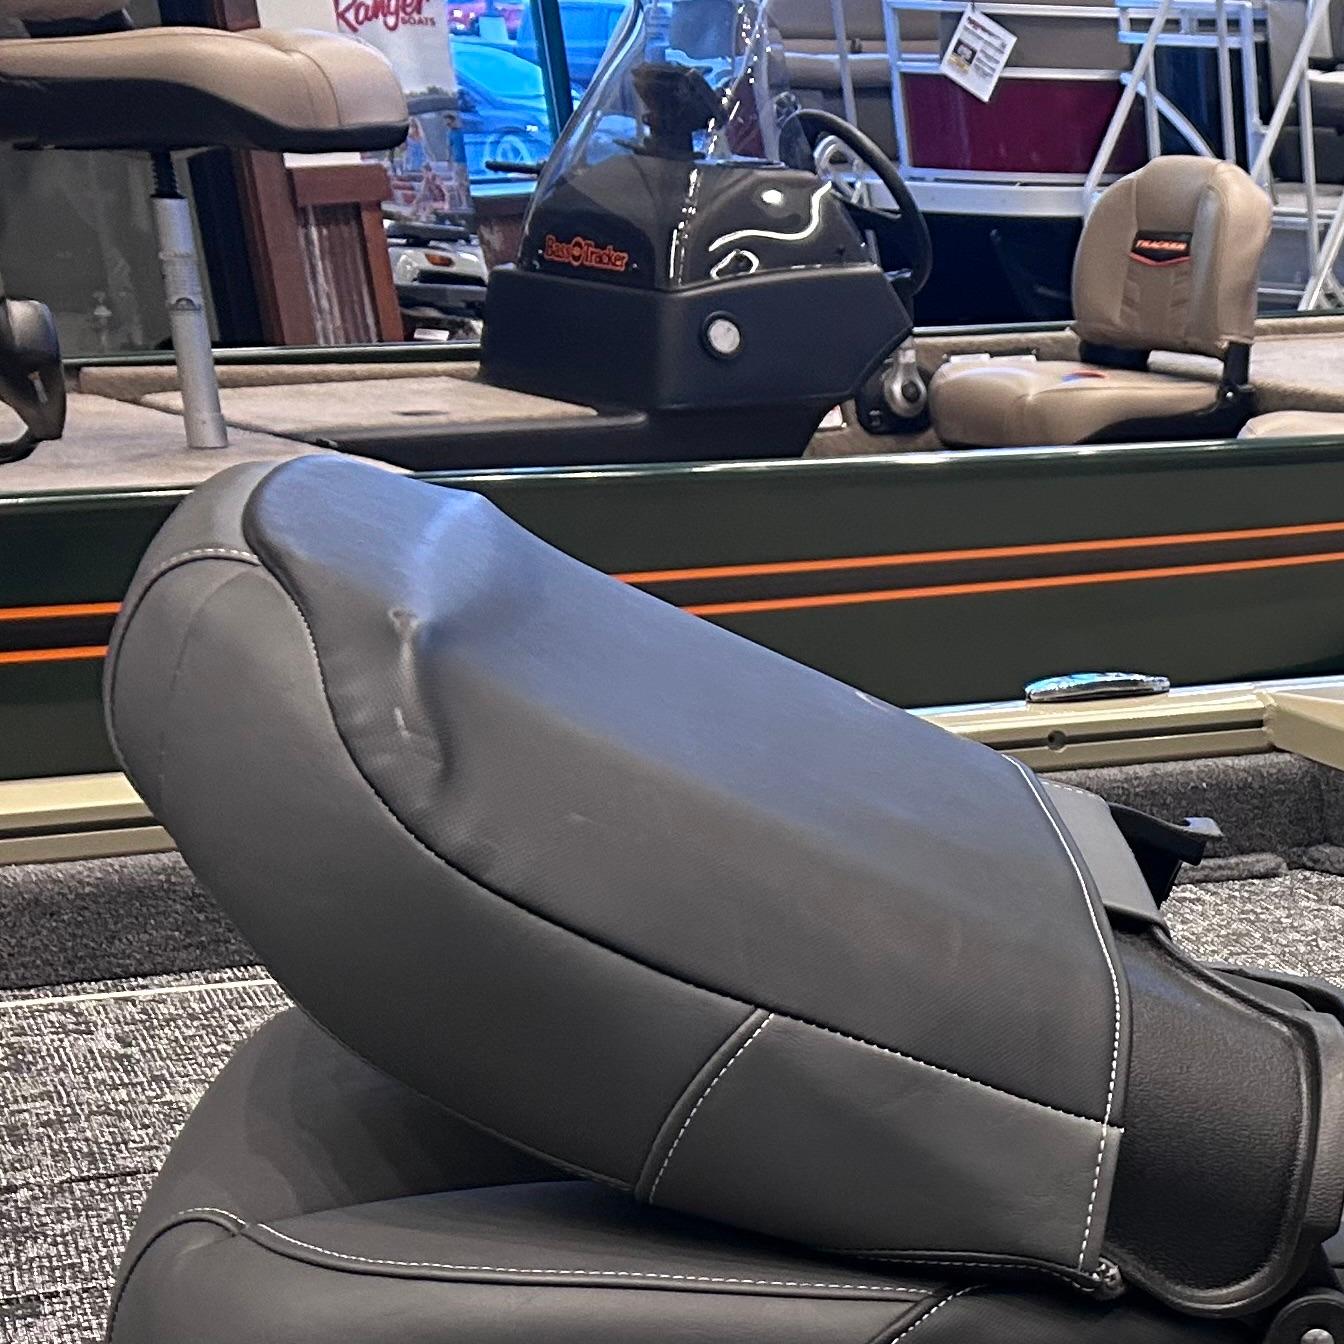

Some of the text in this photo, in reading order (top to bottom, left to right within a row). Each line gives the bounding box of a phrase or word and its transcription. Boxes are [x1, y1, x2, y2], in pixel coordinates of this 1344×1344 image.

[400, 16, 437, 27] BOATS
[1135, 239, 1188, 251] TRACKER
[543, 234, 630, 272] Bass Tracker
